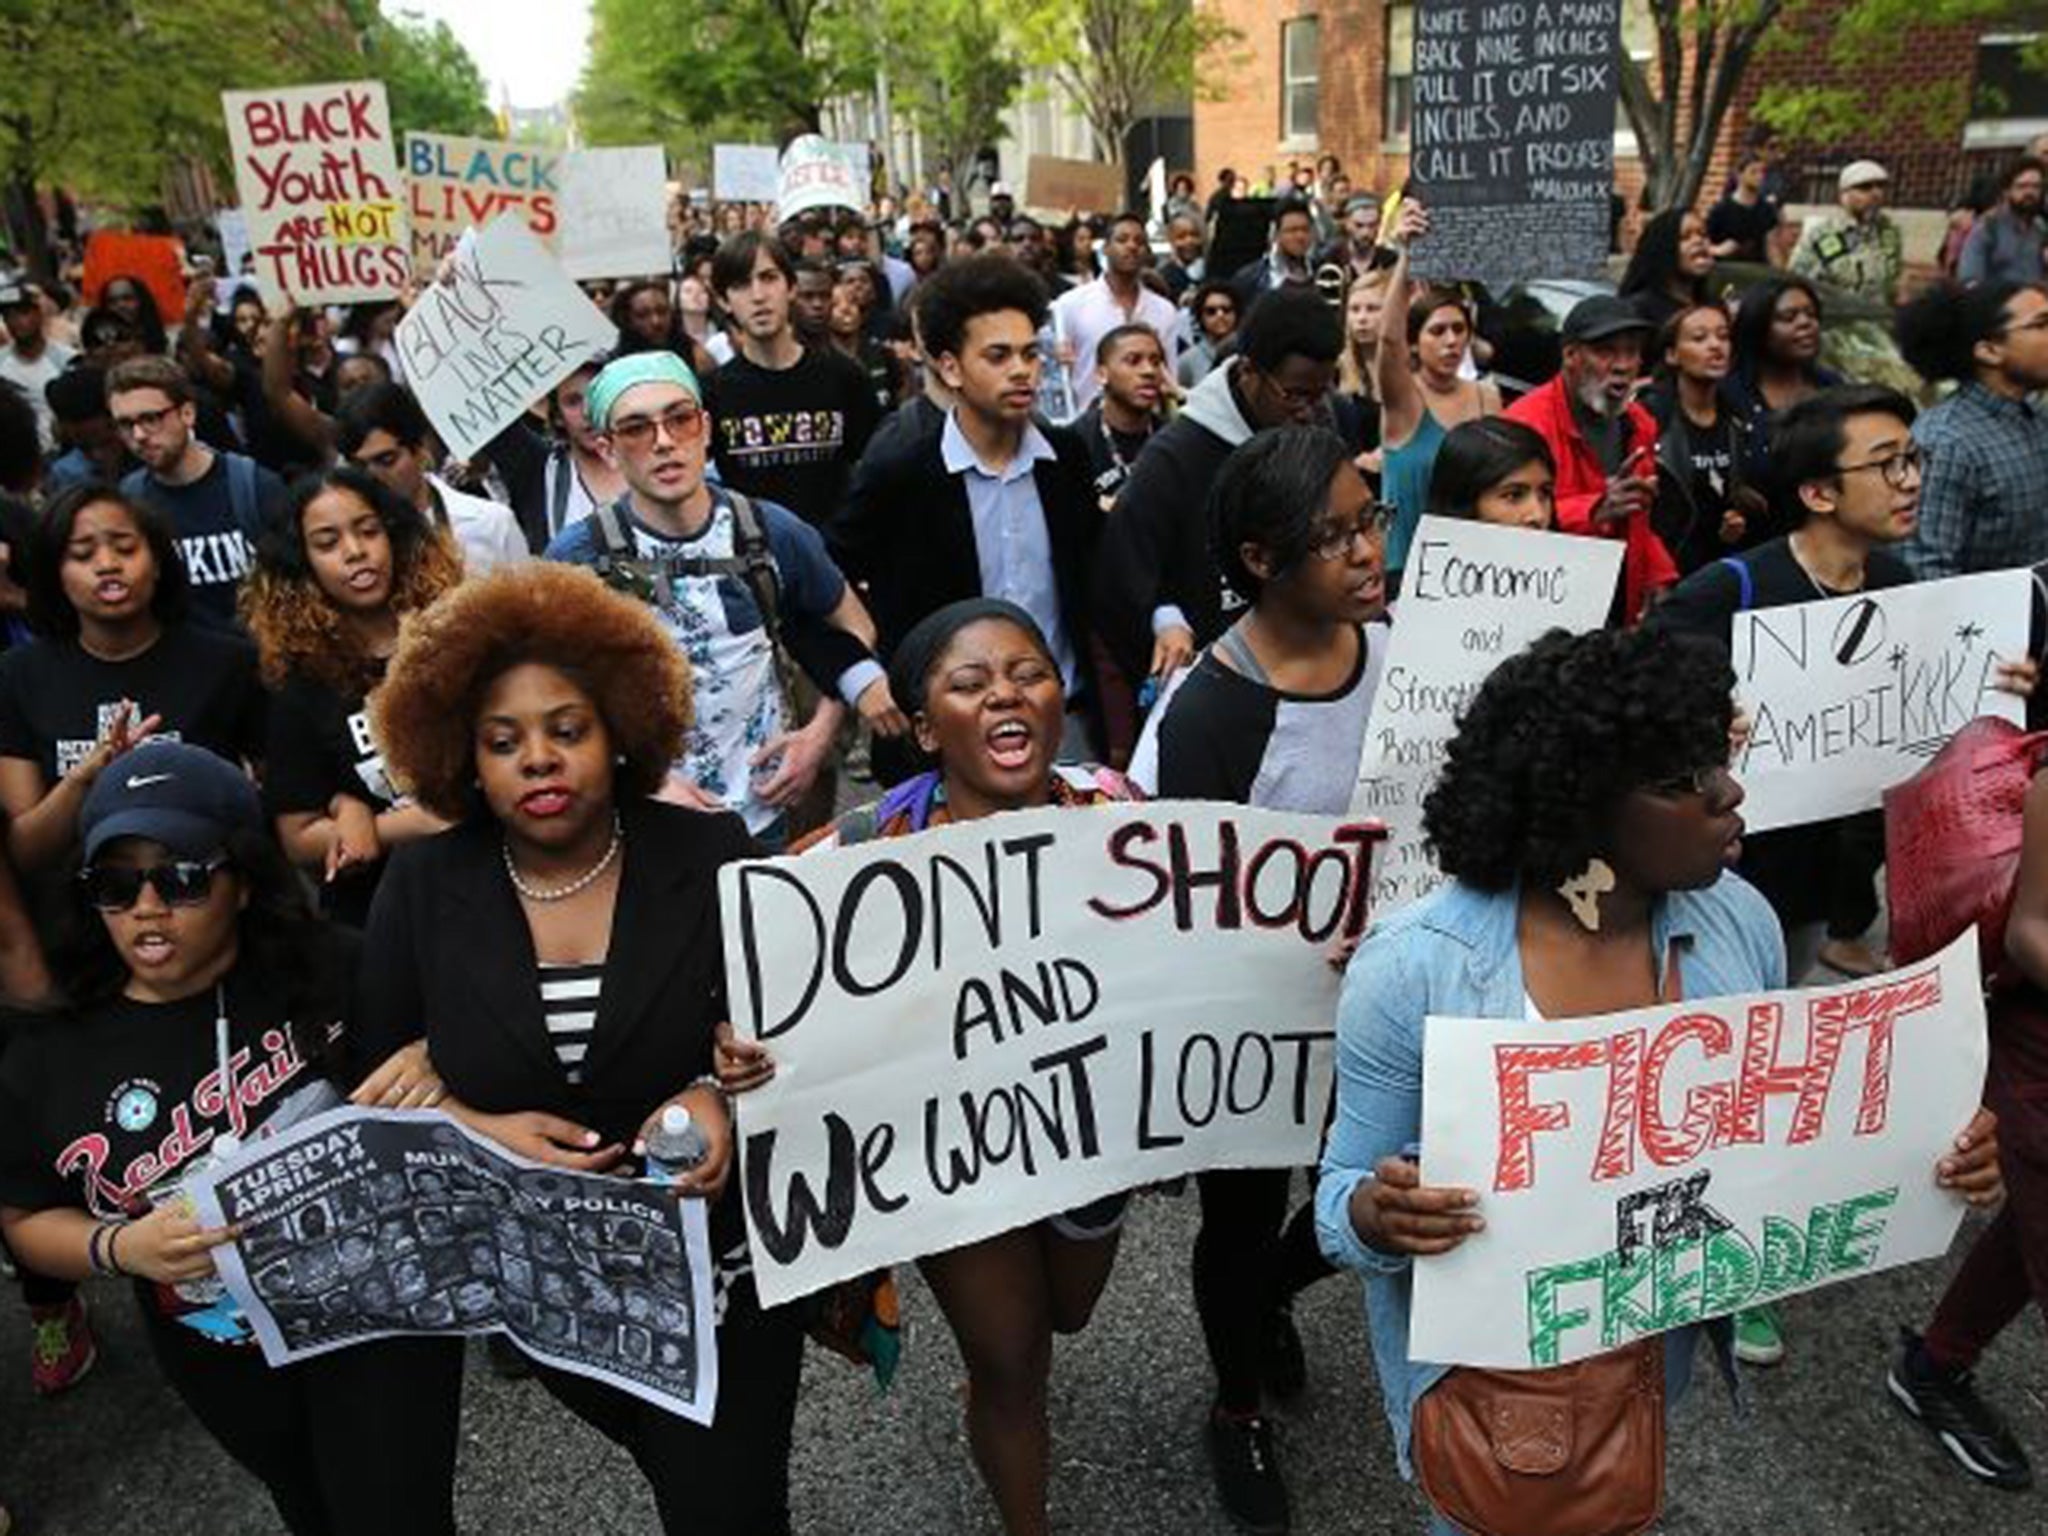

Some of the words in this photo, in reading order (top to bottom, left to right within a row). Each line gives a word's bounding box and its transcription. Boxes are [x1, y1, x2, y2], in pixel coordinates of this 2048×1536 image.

[1416, 38, 1464, 71] BACK
[1475, 34, 1526, 66] NINE
[1534, 30, 1610, 55] INCHES
[1418, 9, 1470, 34] KNIFE
[1482, 4, 1526, 31] INTO
[1534, 3, 1552, 29] A
[1559, 2, 1616, 26] MANS
[244, 89, 381, 146] BLACK
[1414, 73, 1461, 104] PULL
[1473, 71, 1495, 102] IT
[1507, 63, 1555, 97] OUT
[1560, 63, 1609, 93] SIX
[1415, 105, 1510, 145] INCHES,
[1514, 103, 1570, 135] AND
[410, 138, 558, 192] BLACK
[1413, 149, 1476, 183] CALL
[1489, 147, 1513, 176] IT
[1594, 181, 1609, 200] X
[275, 216, 327, 243] ARE
[329, 203, 394, 239] NOT
[257, 245, 406, 291] THUGS
[401, 248, 525, 381] BLACK
[449, 315, 536, 393] LIVES
[449, 323, 589, 446] MATTER
[1415, 541, 1568, 604] Economic
[1462, 624, 1504, 653] and
[1748, 597, 1887, 682] NO
[738, 833, 1055, 1040] DONT
[1087, 819, 1390, 943] SHOOT
[953, 958, 1100, 1060] AND
[925, 1037, 1107, 1195] WONT
[1137, 1030, 1336, 1150] LOOT
[1493, 965, 1941, 1193] FIGHT
[56, 1103, 215, 1219] Red
[225, 1124, 362, 1198] TUESDAY
[235, 1165, 323, 1218] APRIL
[331, 1142, 365, 1169] 14
[563, 1195, 666, 1224] POLICE
[1617, 1168, 1734, 1268] FOR
[1526, 1186, 1898, 1367] FREDDIE
